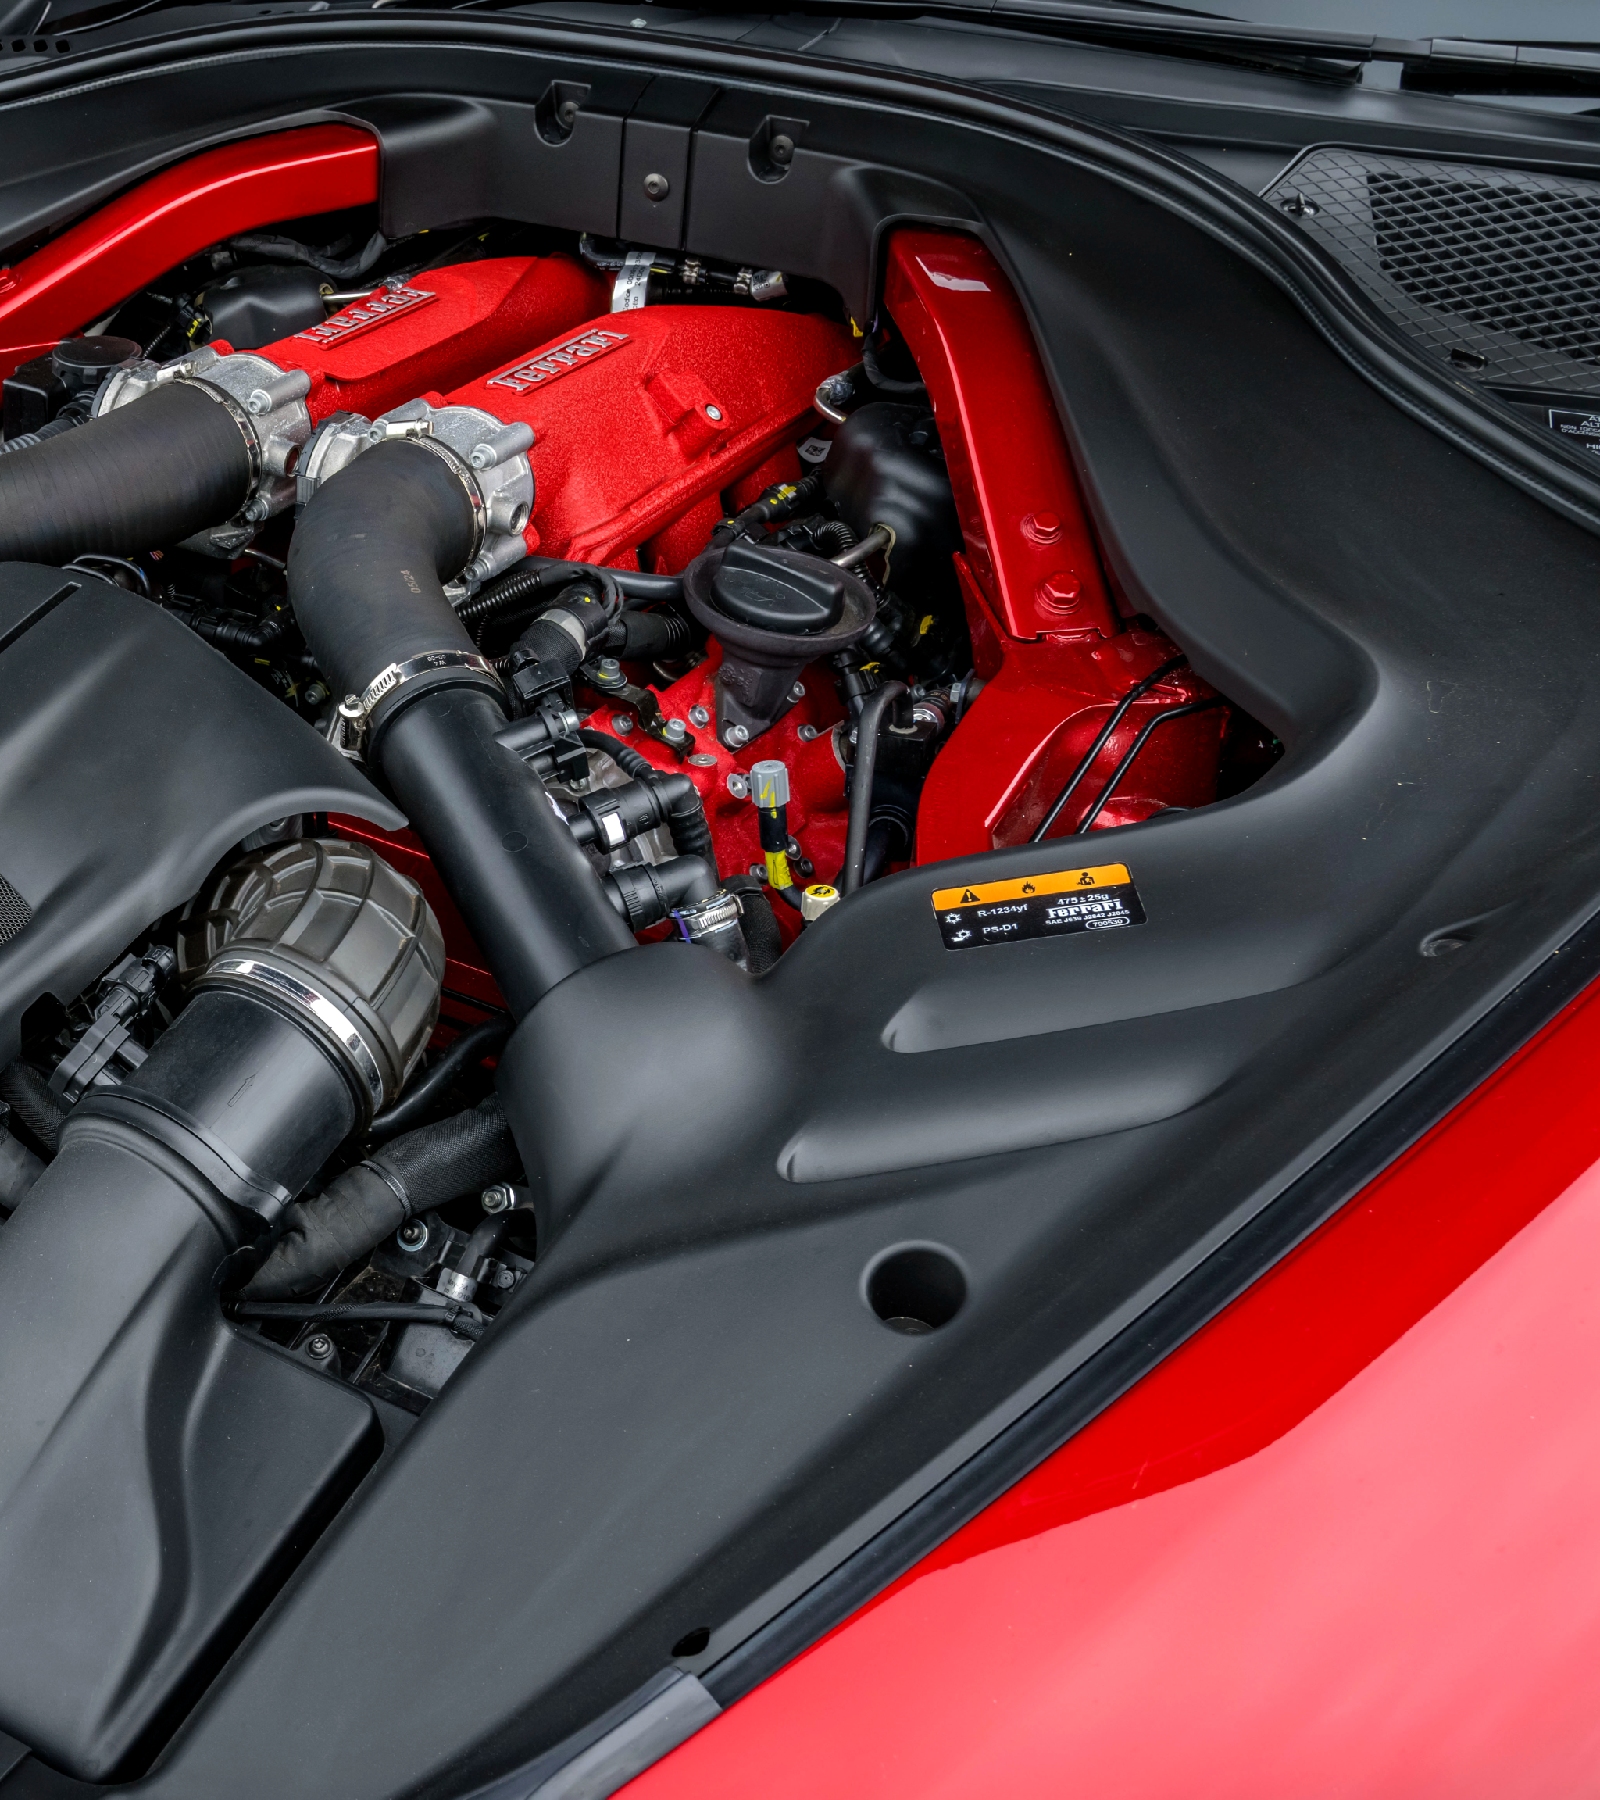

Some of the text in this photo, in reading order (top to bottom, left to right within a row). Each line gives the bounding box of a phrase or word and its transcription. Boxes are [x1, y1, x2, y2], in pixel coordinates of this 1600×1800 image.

[293, 286, 437, 344] Ferrari
[486, 329, 630, 392] Ferrari
[977, 903, 1028, 918] R-1234yf
[1046, 899, 1123, 919] Ferrari
[982, 923, 1018, 934] PS-D1
